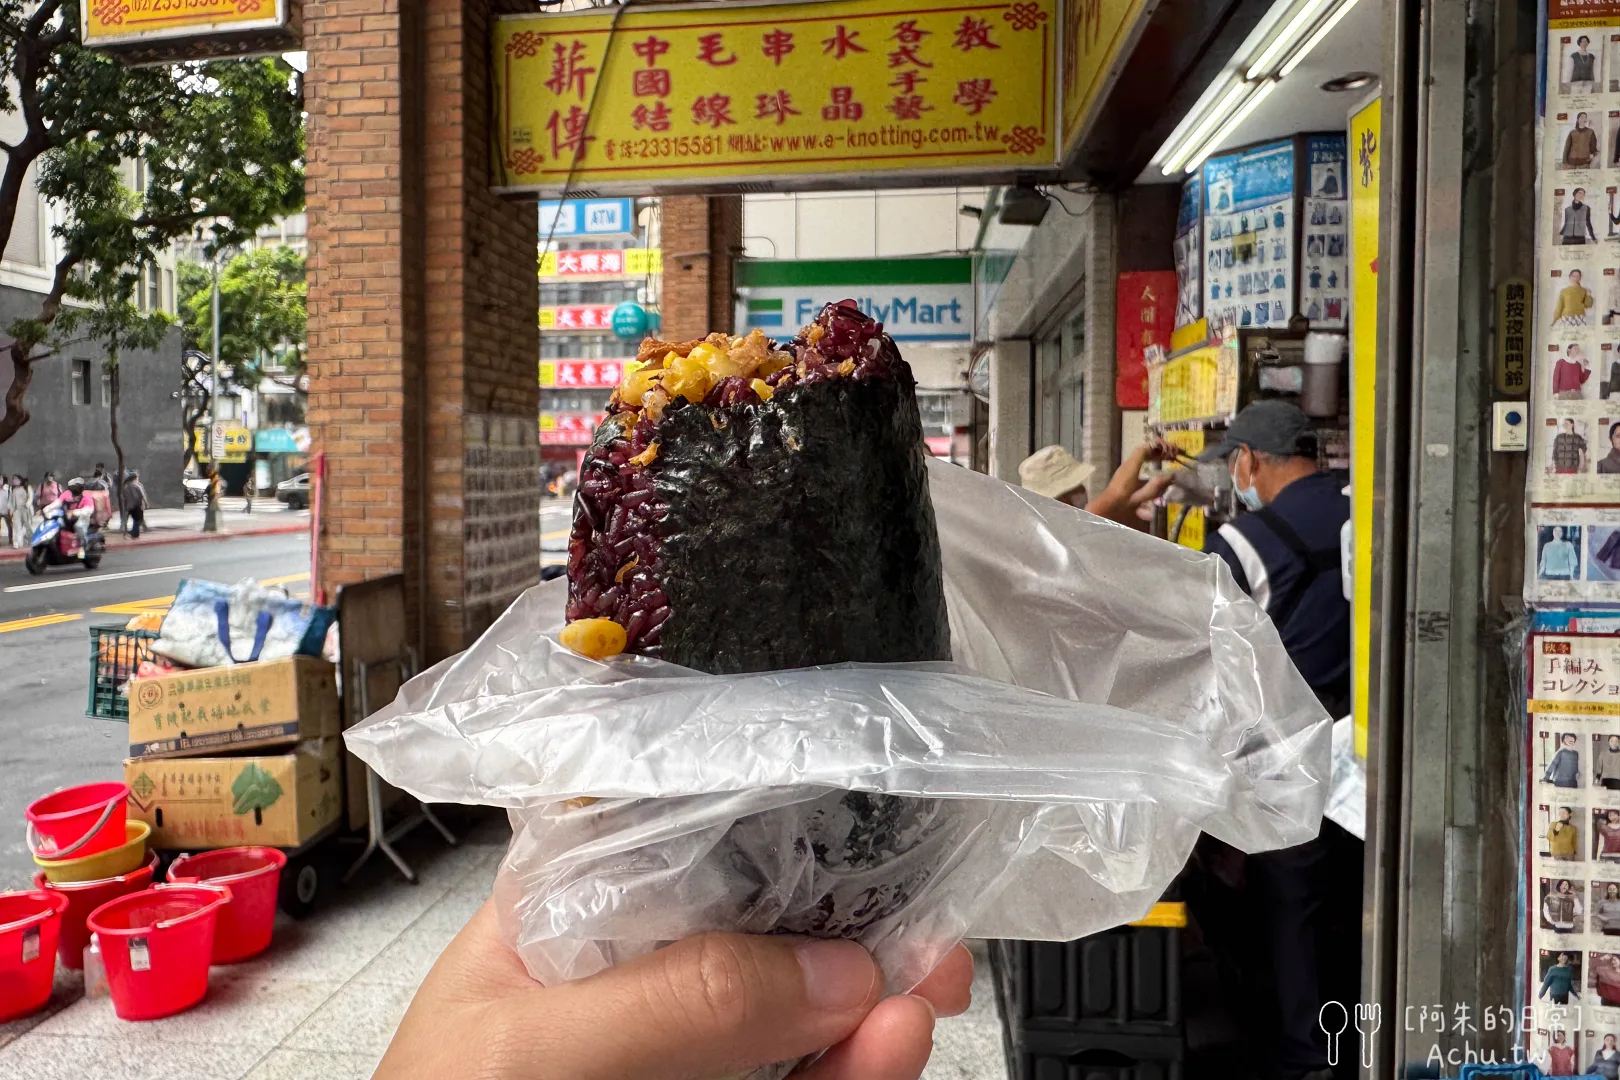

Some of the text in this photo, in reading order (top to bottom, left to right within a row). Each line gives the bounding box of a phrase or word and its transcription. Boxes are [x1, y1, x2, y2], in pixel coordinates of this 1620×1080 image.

[543, 39, 597, 161] 薪傳
[630, 35, 673, 132] 中國結
[690, 32, 739, 128] 毛線
[753, 28, 802, 126] 串球
[820, 24, 869, 122] 水晶
[884, 19, 936, 121] 各式手藝
[951, 15, 1001, 116] 教學
